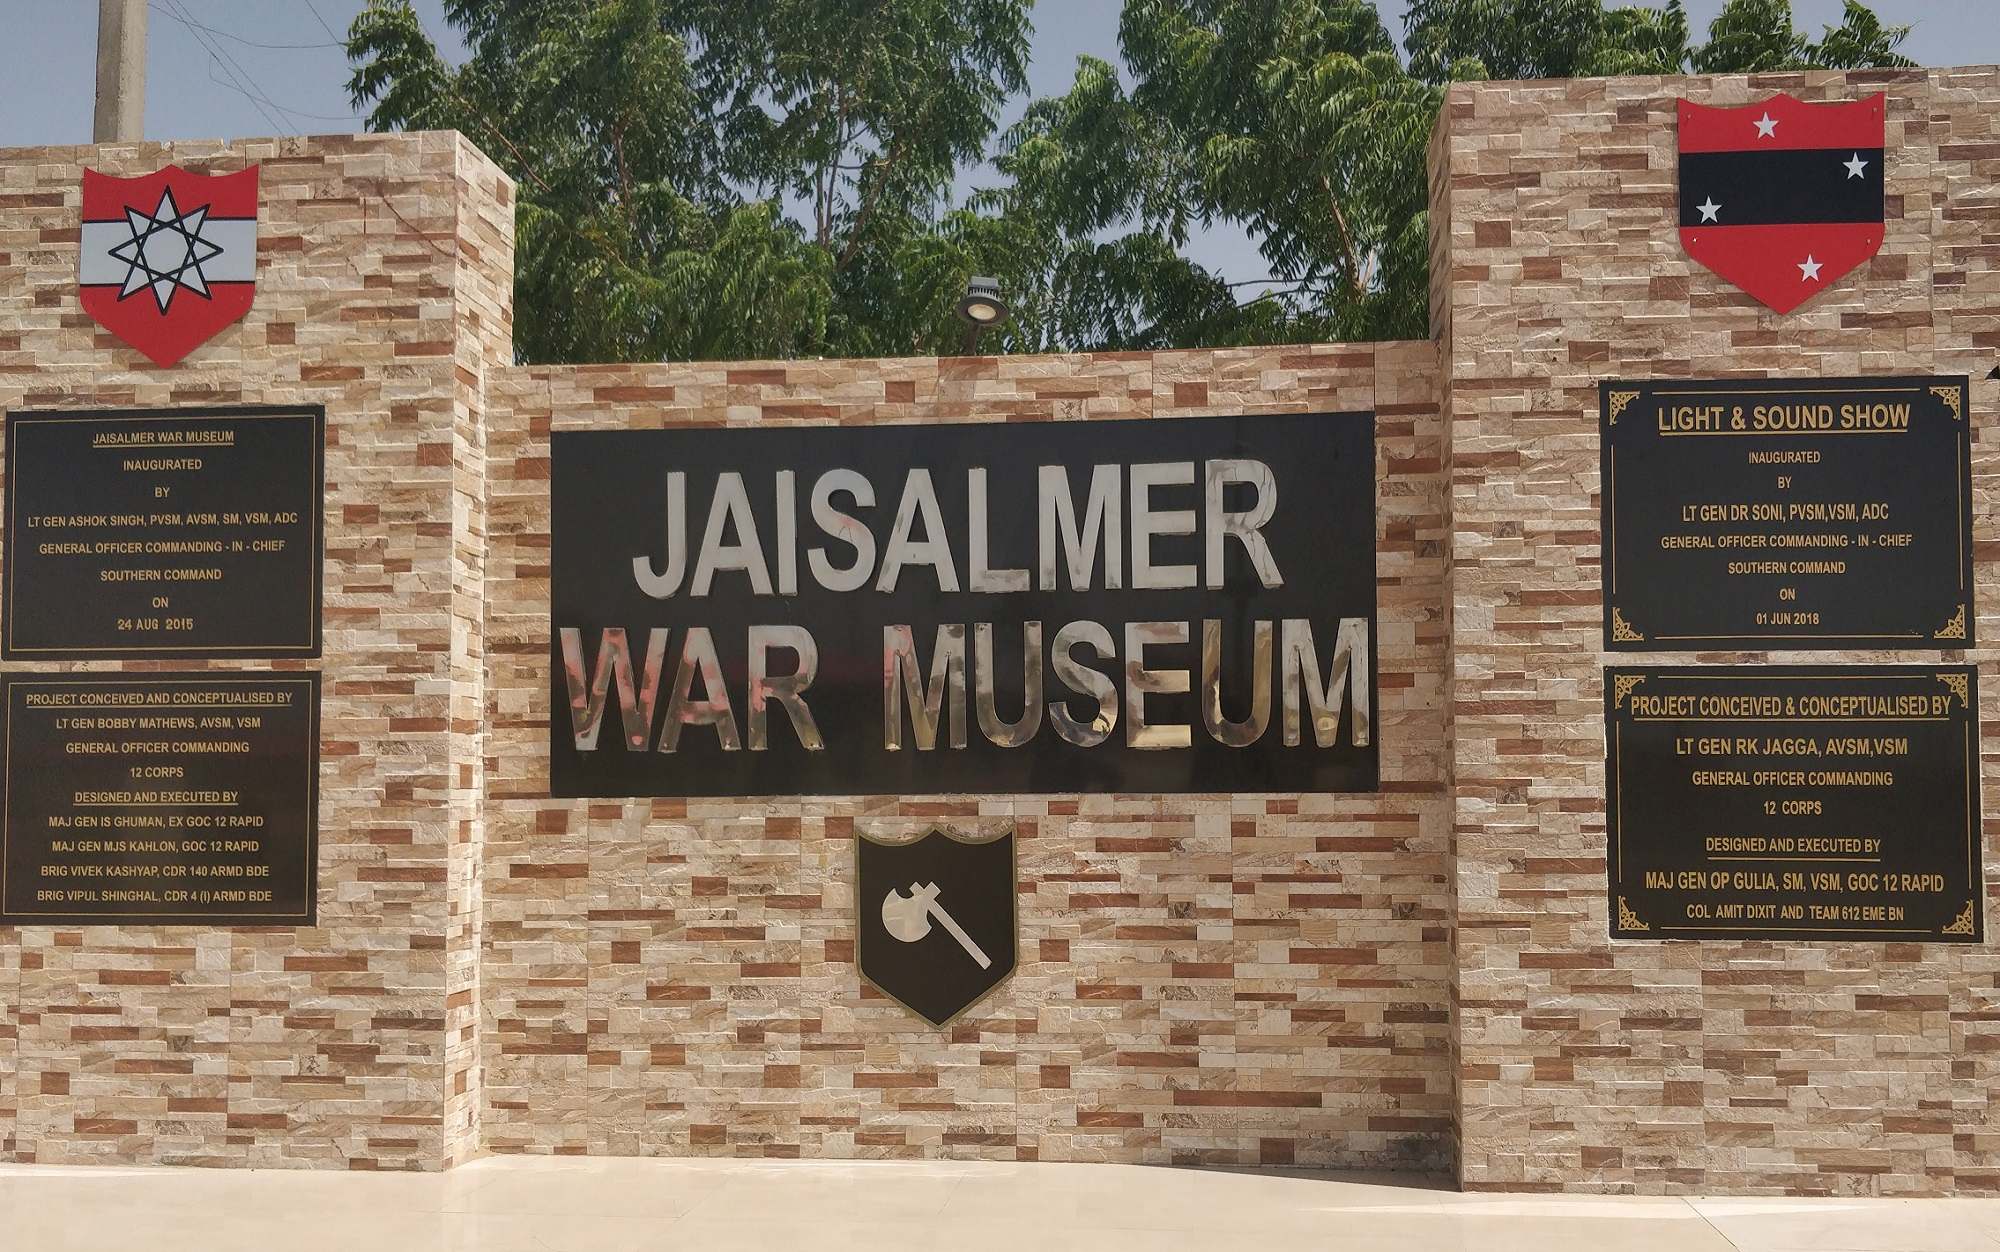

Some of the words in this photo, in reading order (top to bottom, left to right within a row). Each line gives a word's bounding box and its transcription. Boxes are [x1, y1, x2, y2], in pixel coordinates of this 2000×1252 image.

[1659, 407, 1724, 430] LIGHT
[1729, 406, 1746, 430] &
[1754, 406, 1834, 430] SOUND
[1840, 404, 1911, 429] SHOW
[93, 432, 154, 443] JAISALMER
[157, 432, 183, 442] WAR
[186, 431, 234, 443] MUSEUM
[1749, 451, 1821, 464] INAUGURATED
[124, 459, 202, 471] INAUGURATED
[1778, 476, 1791, 488] BY
[155, 487, 170, 497] BY
[1683, 505, 1697, 521] LT
[1700, 505, 1727, 521] GEN
[1730, 504, 1750, 520] DR
[1752, 504, 1786, 523] SONI,
[1862, 503, 1888, 519] ADC
[28, 517, 40, 527] LT
[43, 516, 65, 528] GEN
[69, 516, 108, 527] ASHOK
[110, 515, 147, 527] SINGH,
[150, 514, 183, 525] PVSM,
[186, 514, 219, 525] AVSM,
[223, 513, 241, 525] SM,
[245, 512, 271, 525] VSM,
[274, 512, 297, 523] ADC
[632, 459, 1285, 599] JAISALMER
[40, 543, 92, 554] GENERAL
[96, 542, 142, 553] OFFICER
[146, 541, 222, 553] COMMANDING
[232, 541, 242, 551] IN
[253, 540, 285, 551] CHIEF
[1661, 536, 1715, 548] GENERAL
[1718, 536, 1767, 547] OFFICER
[1770, 535, 1848, 548] COMMANDING
[1857, 534, 1869, 546] IN
[1879, 534, 1912, 546] CHIEF
[1729, 562, 1787, 574] SOUTHERN
[1790, 562, 1845, 574] COMMAND
[101, 570, 160, 581] SOUTHERN
[164, 569, 222, 581] COMMAND
[1779, 588, 1795, 600] ON
[153, 597, 168, 608] ON
[118, 619, 132, 630] 24
[136, 618, 158, 630] AUG
[166, 618, 193, 630] 2015
[1757, 613, 1767, 624] 01
[1771, 612, 1791, 624] JUN
[1793, 613, 1819, 624] 2018
[559, 624, 826, 752] WAR
[883, 617, 1370, 751] MUSEUM
[27, 694, 77, 704] PROJECT
[80, 693, 144, 704] CONCEIVED
[146, 693, 169, 704] AND
[173, 692, 274, 704] CONCEPTUALISED
[277, 692, 293, 703] BY
[1631, 696, 1696, 715] PROJECT
[1700, 696, 1781, 716] CONCEIVED
[1786, 696, 1795, 715] &
[1800, 696, 1928, 716] CONCEPTUALISED
[1932, 696, 1951, 714] BY
[56, 719, 69, 728] LT
[71, 718, 95, 728] GEN
[98, 718, 136, 728] BOBBY
[140, 717, 197, 729] MATHEWS,
[200, 717, 233, 729] AVSM,
[237, 717, 260, 728] VSM
[66, 742, 118, 753] GENERAL
[122, 742, 169, 753] OFFICER
[172, 742, 249, 752] COMMANDING
[1677, 738, 1694, 754] LT
[1699, 738, 1731, 755] GEN
[1736, 738, 1758, 754] RK
[1763, 738, 1821, 758] JAGGA,
[130, 768, 142, 777] 12
[145, 767, 183, 777] CORPS
[1692, 771, 1750, 785] GENERAL
[1753, 772, 1807, 785] OFFICER
[1809, 772, 1893, 785] COMMANDING
[75, 792, 131, 802] DESIGNED
[134, 792, 157, 802] AND
[160, 791, 219, 802] EXECUTED
[223, 791, 238, 802] BY
[1764, 801, 1776, 814] 12
[1782, 801, 1822, 815] CORPS
[49, 816, 71, 827] MAJ
[75, 816, 97, 827] GEN
[101, 817, 111, 827] IS
[114, 816, 165, 828] GHUMAN,
[169, 816, 183, 827] EX
[187, 816, 211, 827] GOC
[215, 816, 226, 826] 12
[230, 816, 263, 827] RAPID
[52, 841, 74, 851] MAJ
[78, 841, 101, 852] GEN
[104, 841, 126, 851] MJS
[130, 841, 178, 853] KAHLON,
[182, 841, 206, 851] GOC
[210, 841, 222, 851] 12
[225, 841, 259, 852] RAPID
[1706, 837, 1766, 851] DESIGNED
[1769, 838, 1794, 852] AND
[1798, 838, 1861, 852] EXECUTED
[1864, 839, 1881, 852] BY
[41, 866, 67, 876] BRIG
[71, 865, 103, 876] VIVEK
[106, 864, 159, 878] KASHYAP,
[163, 866, 186, 876] CDR
[190, 866, 207, 876] 140
[210, 866, 243, 876] ARMD
[246, 866, 269, 876] BDE
[1646, 872, 1673, 889] MAJ
[1678, 872, 1706, 889] GEN
[1711, 872, 1729, 889] OP
[1734, 872, 1779, 891] GULIA,
[1783, 873, 1806, 892] SM,
[1810, 873, 1843, 893] VSM,
[1848, 872, 1878, 891] GOC
[1883, 874, 1897, 891] 12
[1902, 873, 1944, 892] RAPID
[37, 890, 64, 901] BRIG
[67, 891, 98, 901] VIPUL
[101, 890, 161, 902] SHINGHAL,
[164, 890, 188, 901] CDR
[191, 891, 197, 901] 4
[213, 891, 246, 901] ARMD
[248, 891, 272, 901] BDE
[1687, 904, 1711, 918] COL
[1716, 904, 1744, 918] AMIT
[1747, 905, 1776, 918] DIXIT
[1781, 905, 1803, 919] AND
[1809, 906, 1839, 919] TEAM
[1842, 906, 1859, 920] 612
[1863, 907, 1885, 920] EME
[1889, 906, 1903, 920] BN
